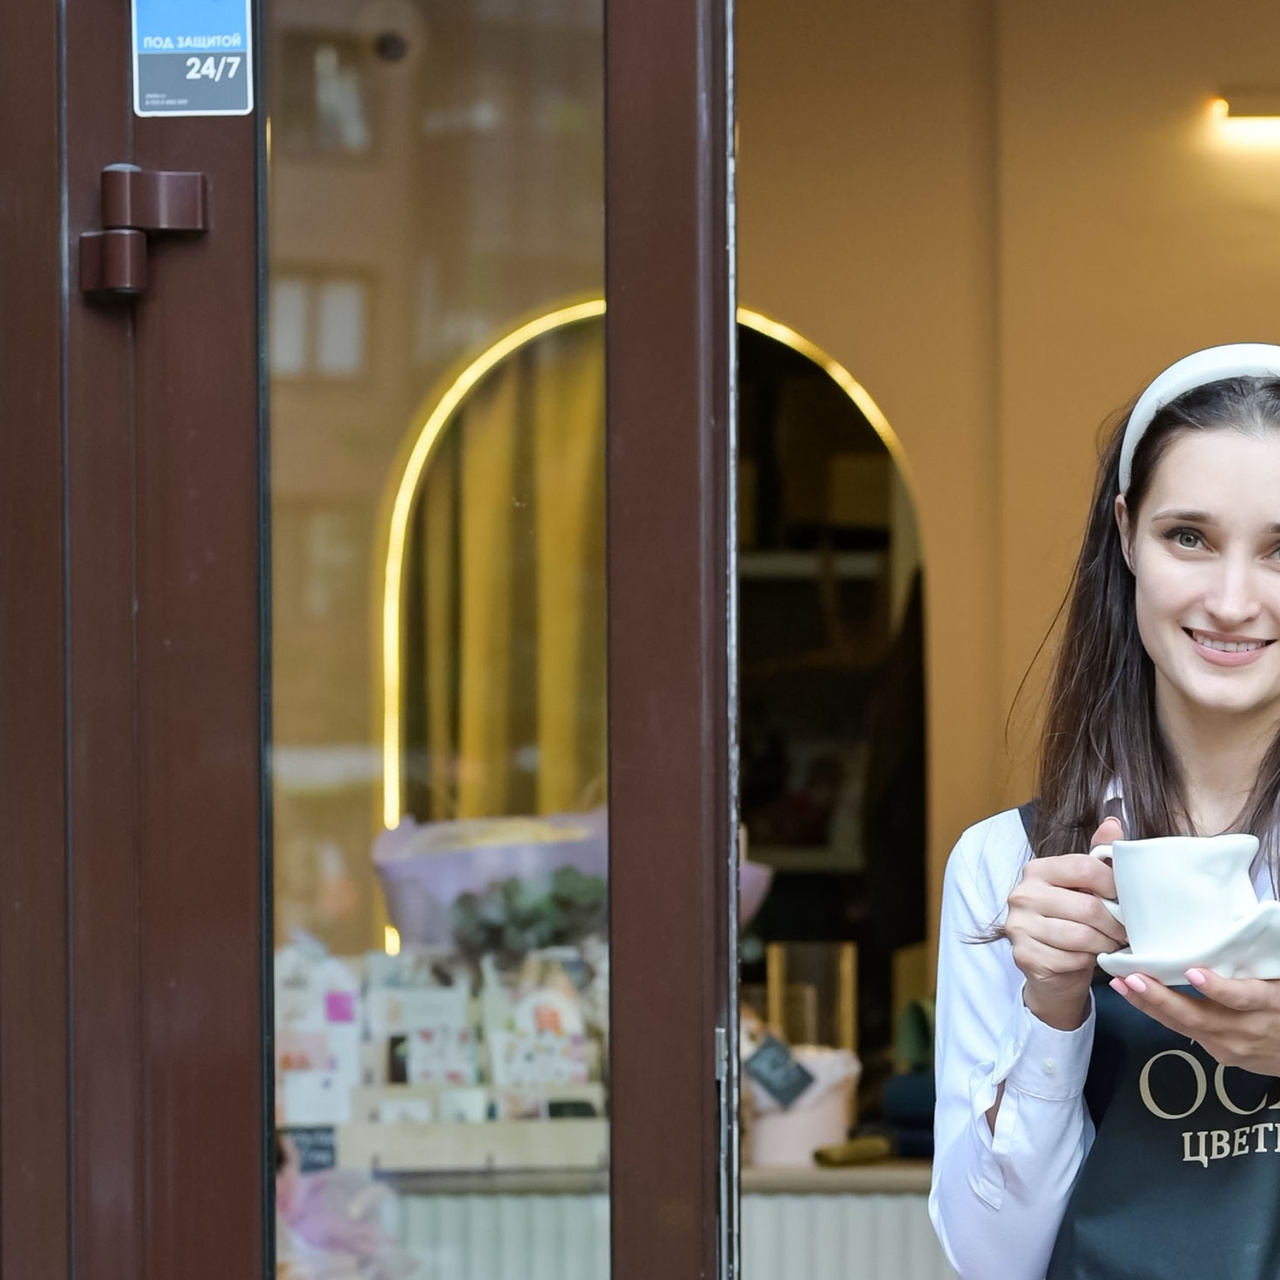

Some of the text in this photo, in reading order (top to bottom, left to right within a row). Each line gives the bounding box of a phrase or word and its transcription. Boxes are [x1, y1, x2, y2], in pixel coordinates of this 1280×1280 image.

[143, 33, 241, 49] ПОД ЗАЩИТОЙ
[185, 56, 241, 82] 24/7
